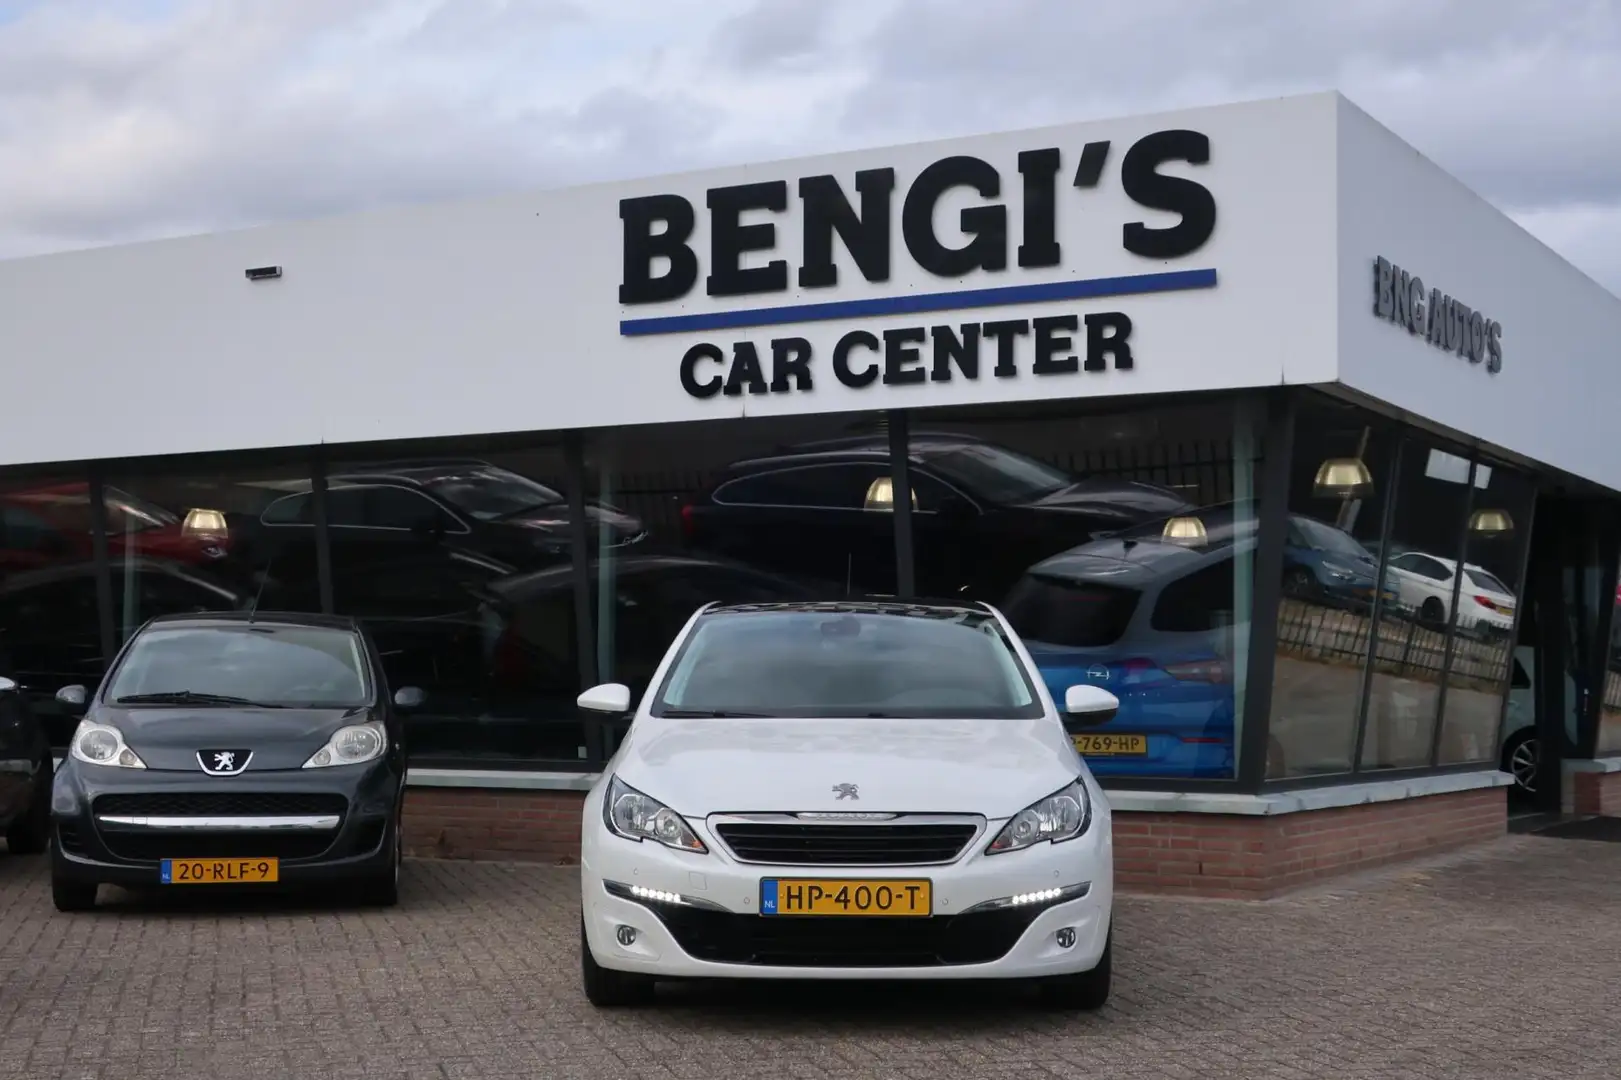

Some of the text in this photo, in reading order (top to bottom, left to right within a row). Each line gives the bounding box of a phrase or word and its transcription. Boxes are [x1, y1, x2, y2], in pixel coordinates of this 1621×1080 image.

[619, 129, 1216, 304] BENGI'S
[680, 311, 1134, 399] CAR CENTER
[1373, 255, 1502, 374] BNG AUTO'S
[179, 861, 270, 880] 20-RLF-9
[764, 885, 921, 910] NL HP-400-T
